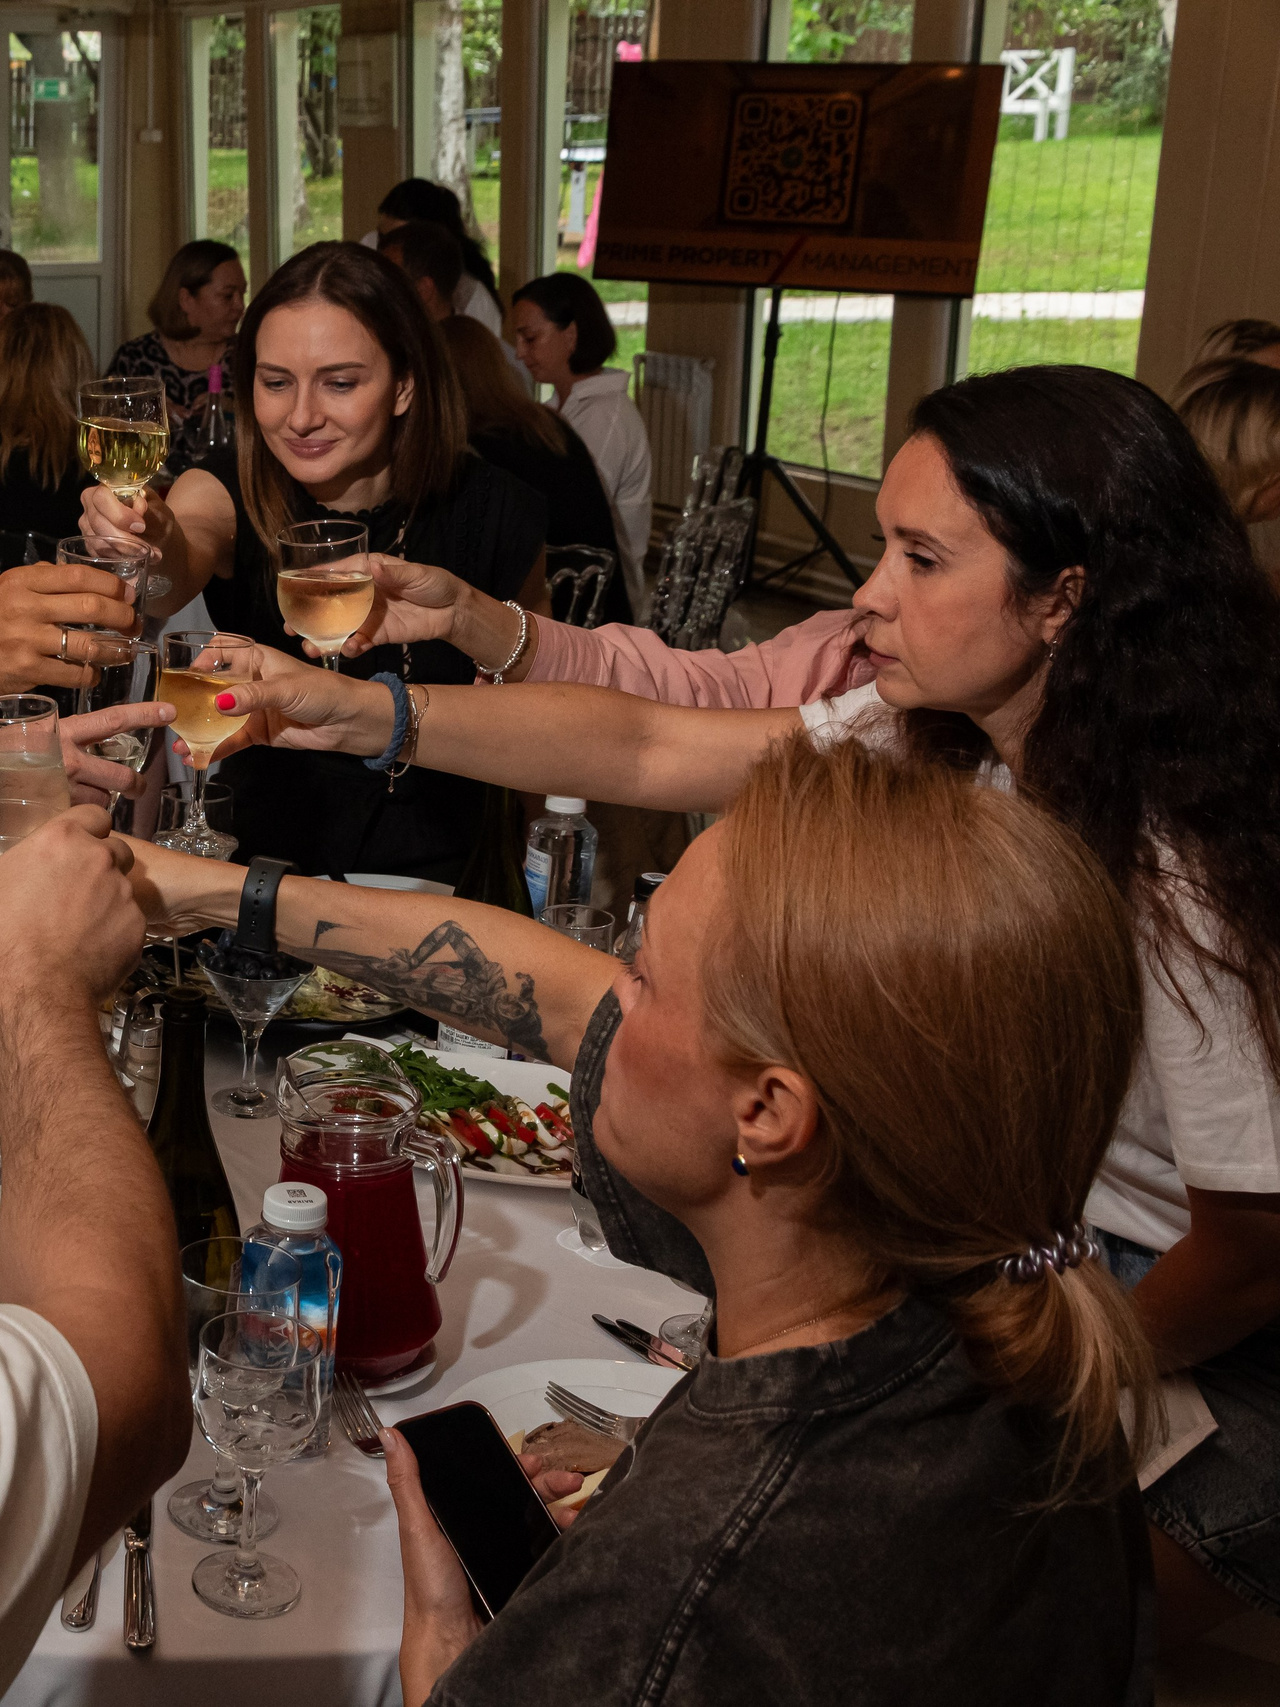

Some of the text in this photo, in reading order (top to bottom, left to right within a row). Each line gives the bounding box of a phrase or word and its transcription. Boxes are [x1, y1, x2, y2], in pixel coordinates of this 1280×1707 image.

[596, 242, 976, 277] PRIME PROPERTY MANAGEMENT
